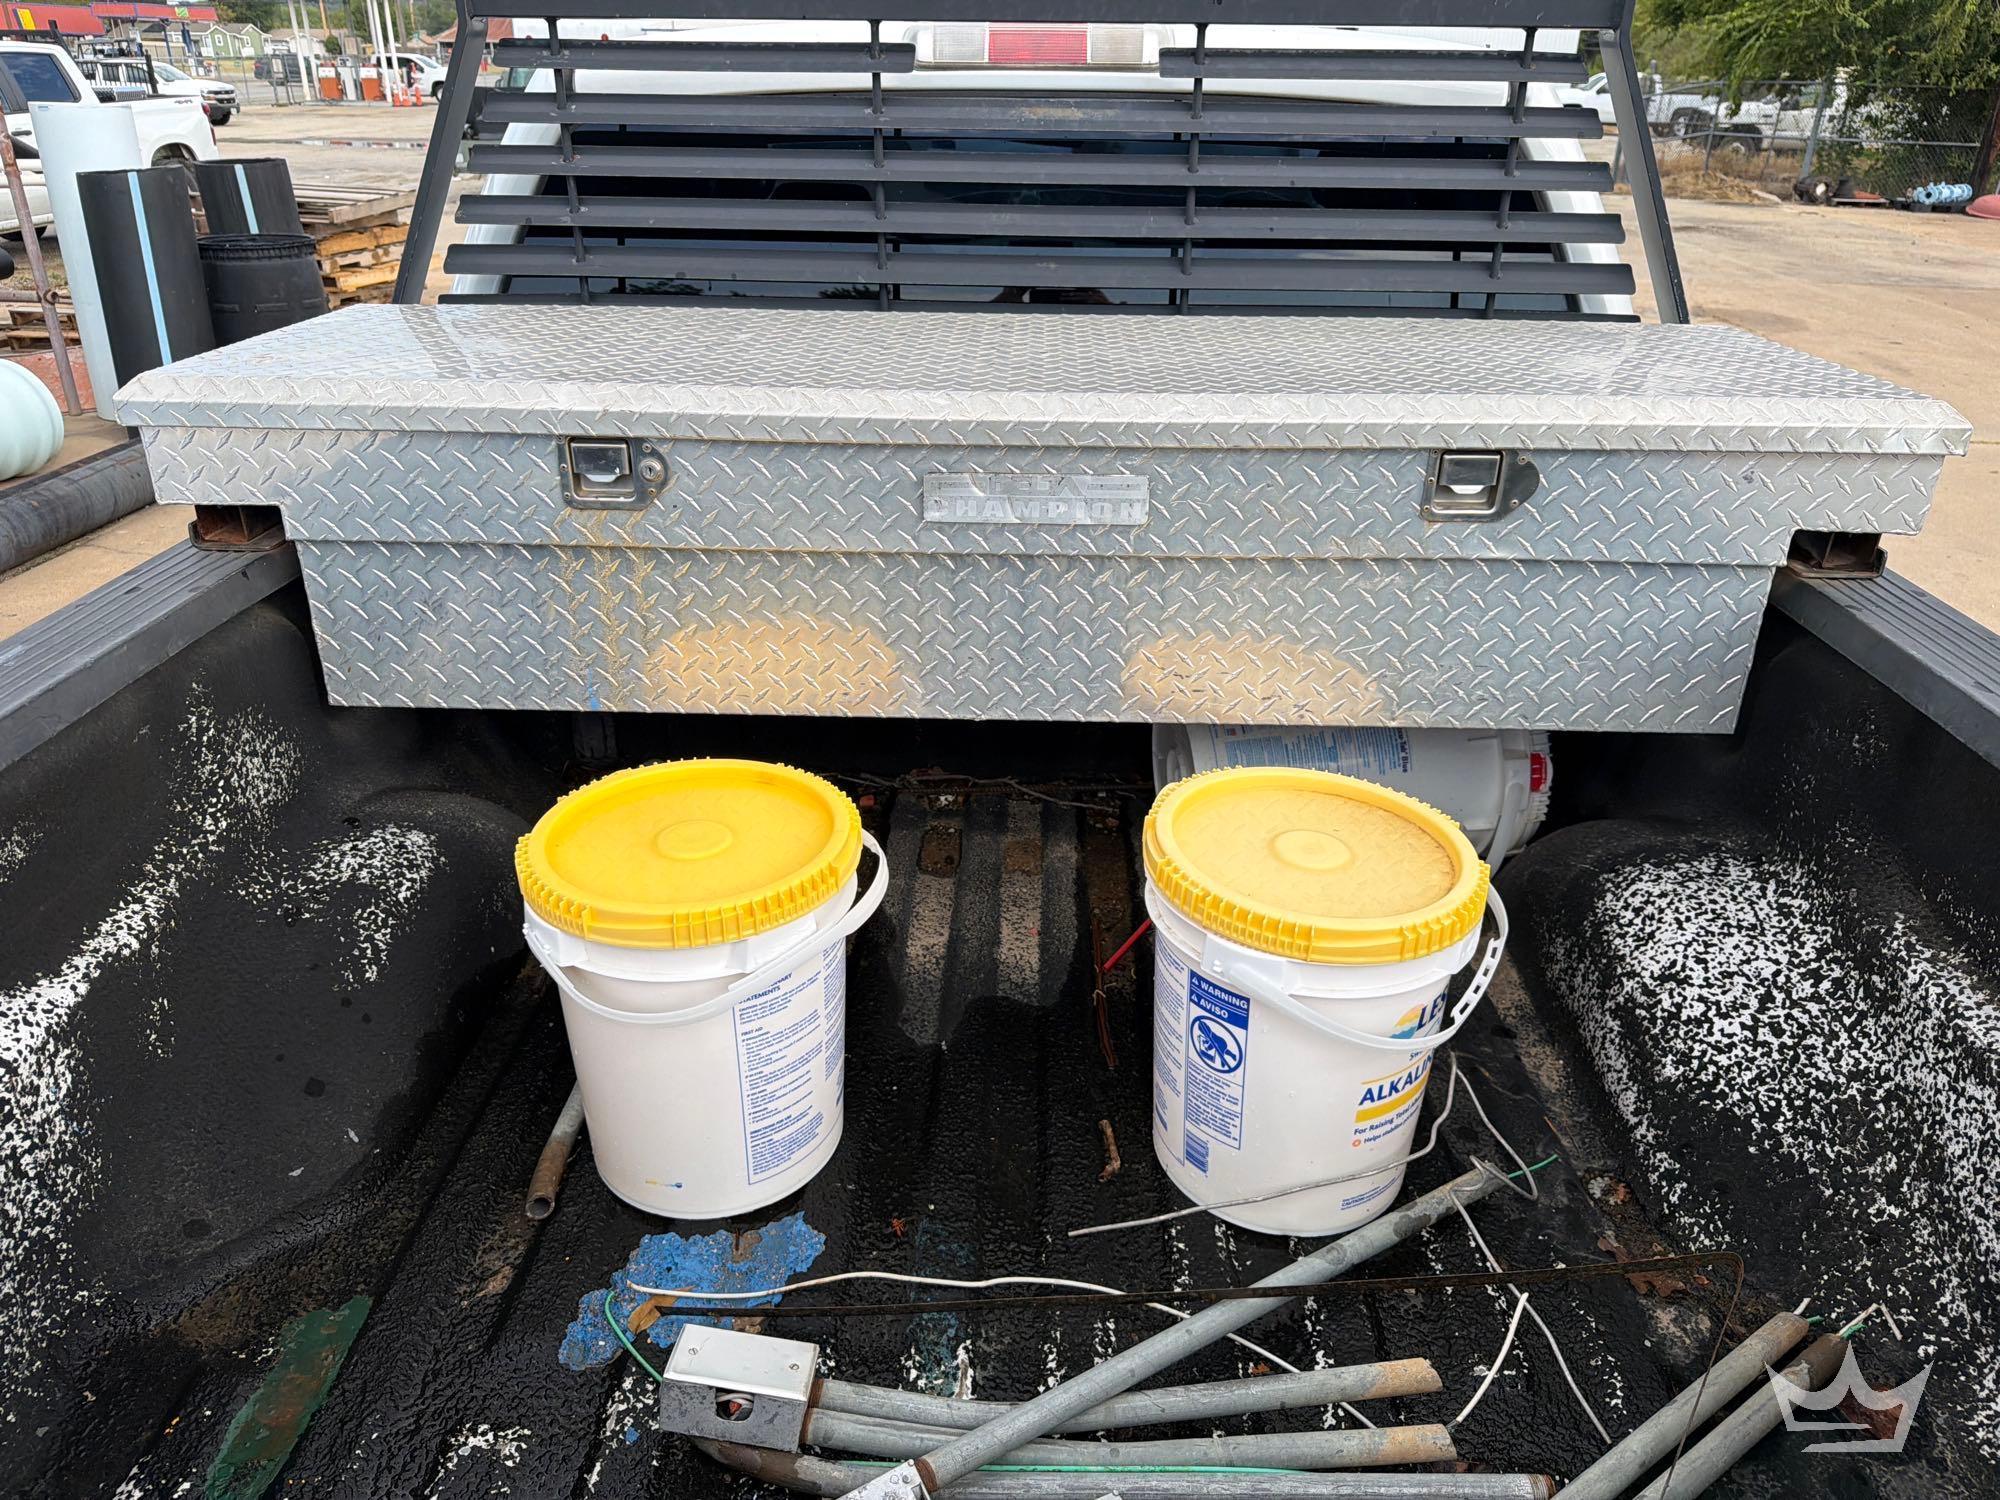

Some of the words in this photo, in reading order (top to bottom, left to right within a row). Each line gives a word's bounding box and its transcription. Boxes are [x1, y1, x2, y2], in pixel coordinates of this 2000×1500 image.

[1200, 980, 1249, 1009] WARNING
[1200, 998, 1229, 1019] AVISO
[1353, 1127, 1368, 1136] For
[1369, 1117, 1395, 1132] Raising
